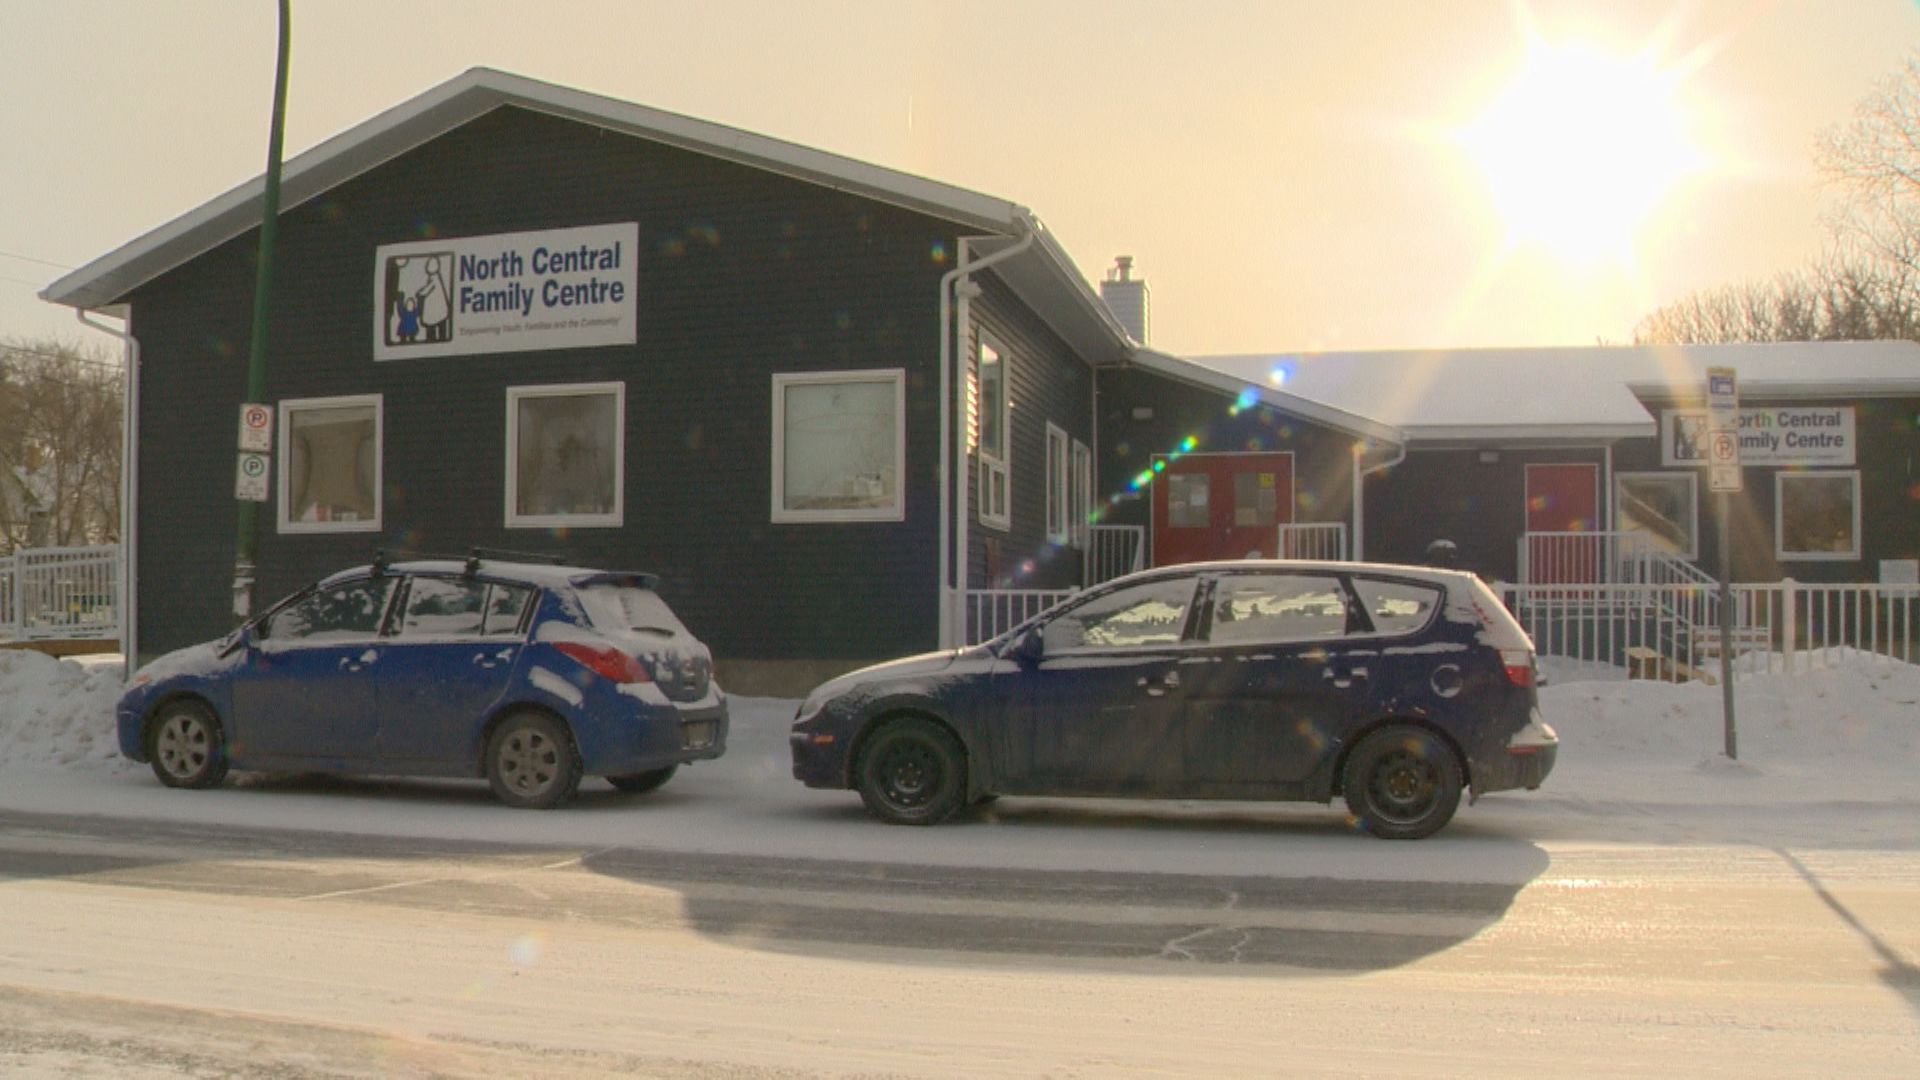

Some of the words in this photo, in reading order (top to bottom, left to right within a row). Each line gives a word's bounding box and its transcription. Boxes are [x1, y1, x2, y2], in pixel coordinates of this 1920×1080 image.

[459, 250, 524, 282] North
[532, 241, 620, 275] Central
[459, 282, 534, 317] Family
[542, 277, 625, 308] Centre
[1738, 411, 1772, 428] orth
[1777, 411, 1841, 428] Central
[1785, 431, 1844, 448] Centre
[250, 461, 259, 472] P
